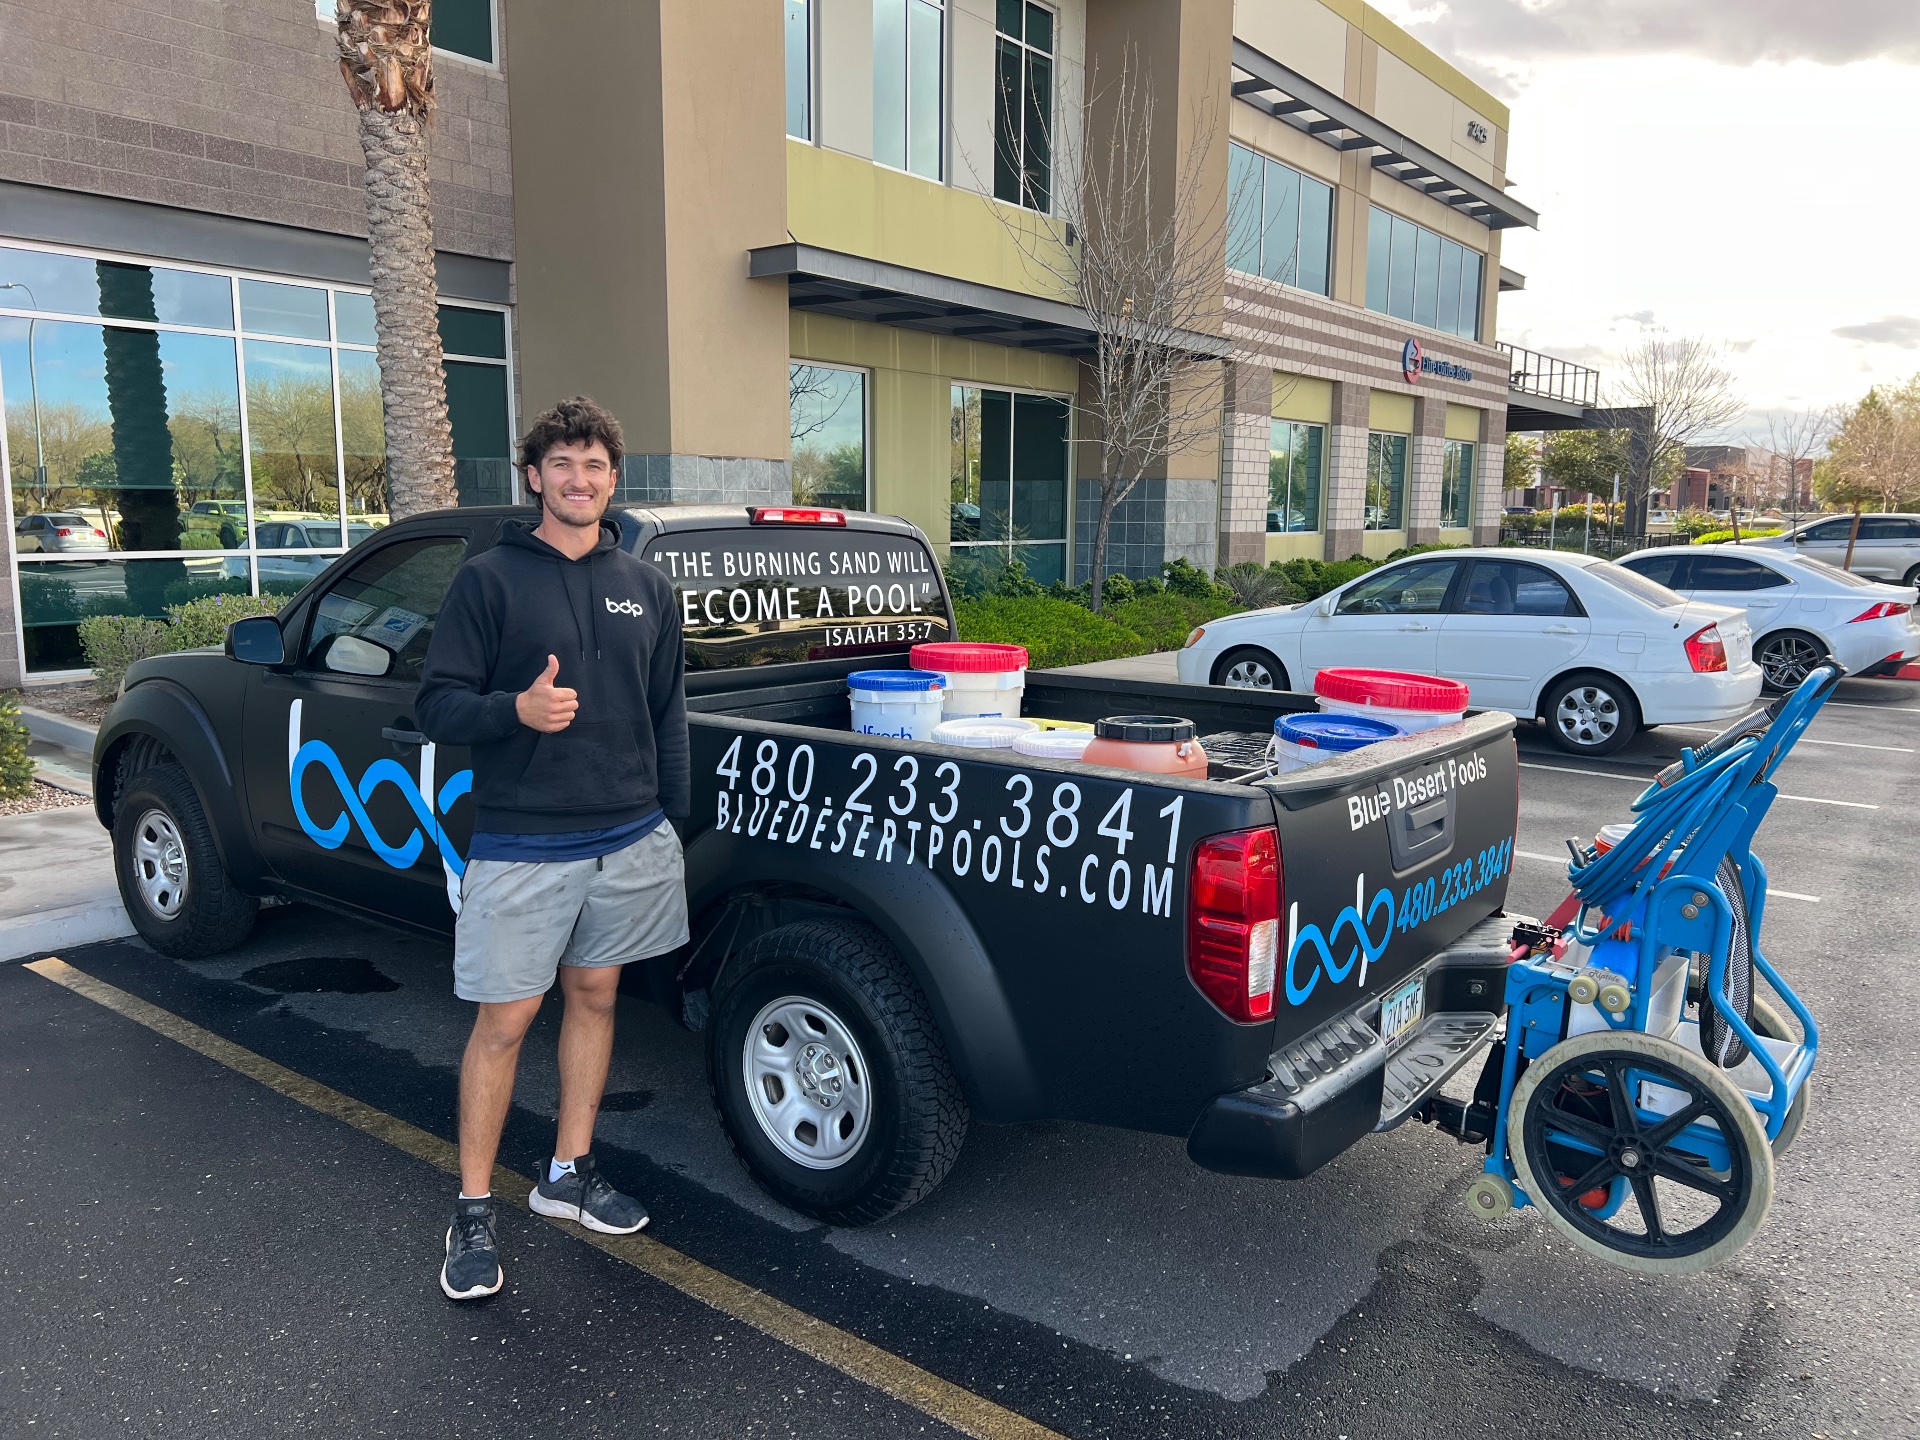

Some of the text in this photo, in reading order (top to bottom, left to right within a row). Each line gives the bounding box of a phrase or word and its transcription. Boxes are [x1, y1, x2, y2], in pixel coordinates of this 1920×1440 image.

[723, 551, 821, 577] BURNING
[830, 551, 881, 574] SAND
[887, 551, 929, 573] WILL
[682, 587, 801, 625] ECOME
[816, 586, 834, 618] A
[825, 622, 932, 647] ISAIAH 35:7
[716, 735, 1184, 864] 480.233.3841
[1347, 752, 1487, 831] Blue Desert Pools
[716, 790, 1173, 918] BLUEDESERTPOOLS.COM
[1397, 835, 1513, 934] 480.233.3841
[1589, 969, 1620, 983] Riptide
